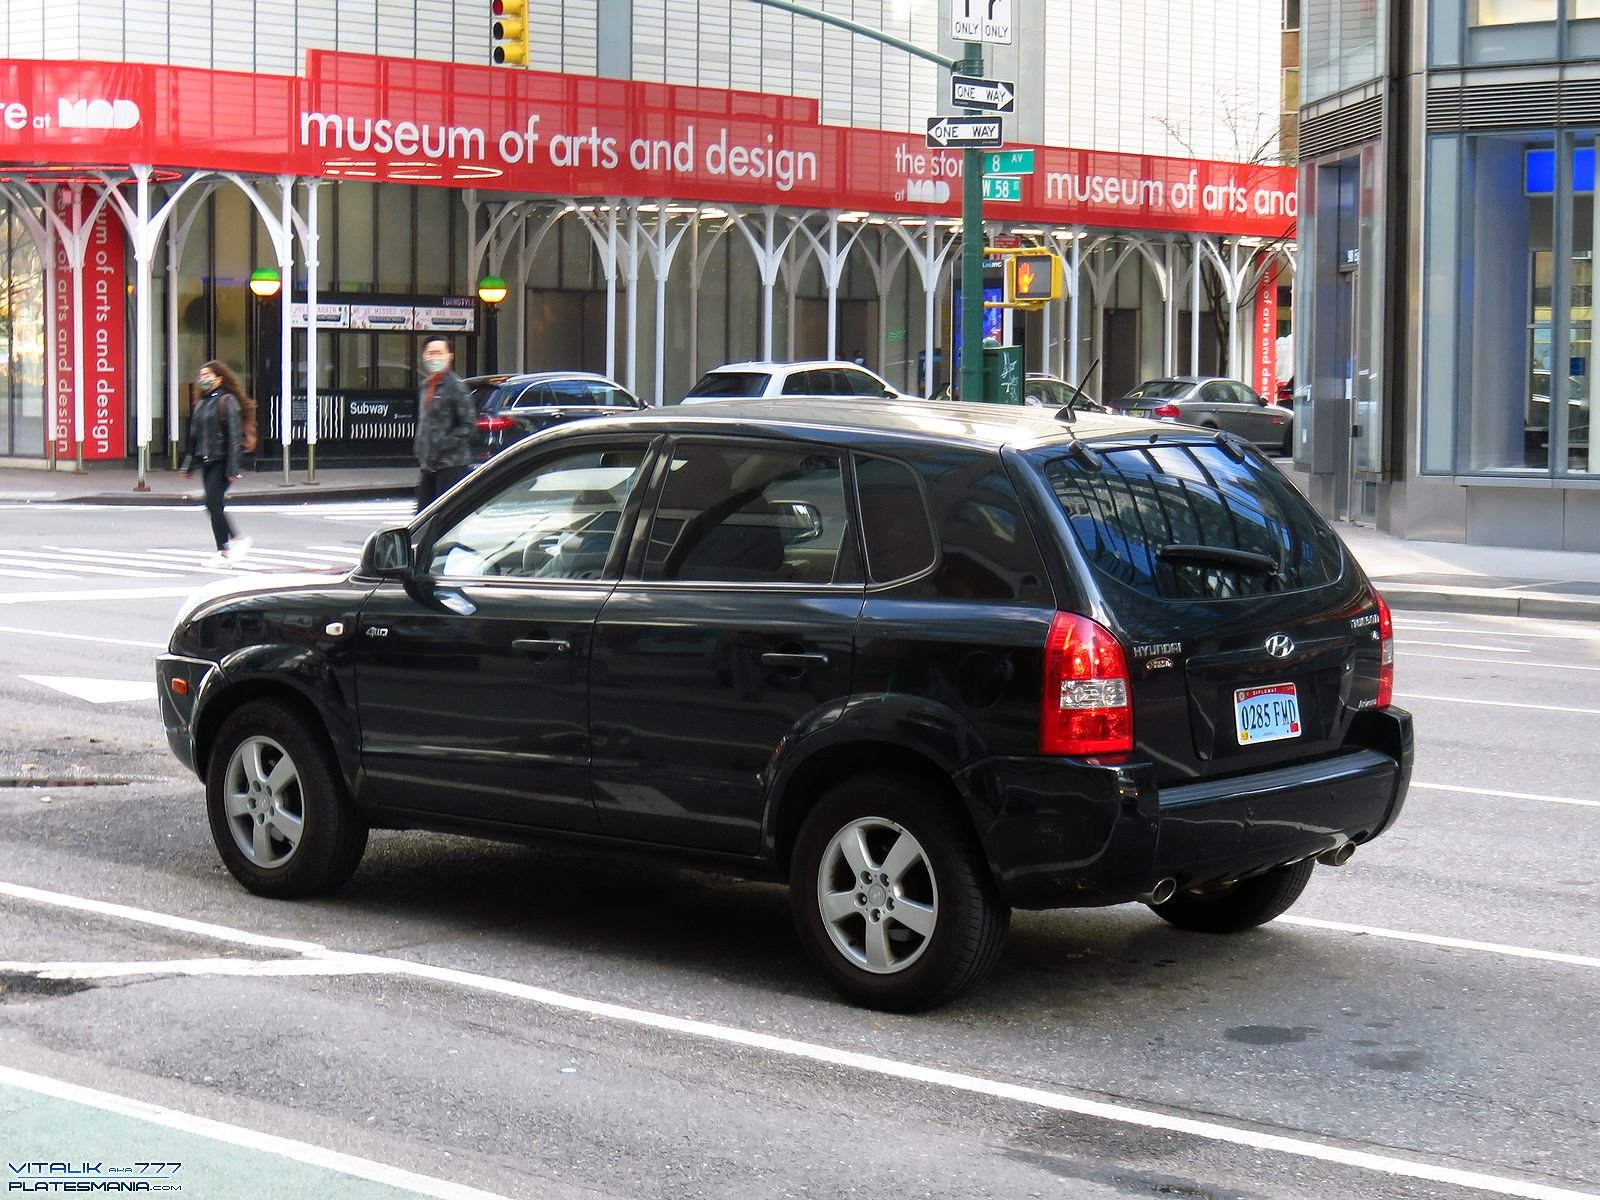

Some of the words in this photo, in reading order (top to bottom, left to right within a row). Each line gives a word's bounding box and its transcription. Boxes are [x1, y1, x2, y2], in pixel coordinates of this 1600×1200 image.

[955, 21, 979, 35] ONLY
[985, 25, 1008, 38] ONLY
[957, 86, 975, 99] ONE
[986, 89, 1006, 101] WAY
[33, 113, 50, 128] at
[935, 126, 959, 138] ONE
[972, 126, 996, 138] WAY
[301, 112, 485, 161] museum
[500, 115, 540, 164] of
[549, 126, 619, 169] arts
[630, 125, 694, 172] and
[706, 128, 816, 191] design
[895, 143, 925, 175] the
[992, 155, 1000, 172] 8
[1011, 154, 1023, 163] AV
[982, 180, 991, 197] W
[995, 180, 1009, 198] 58
[1047, 172, 1163, 206] museum
[1171, 169, 1197, 208] of
[1202, 178, 1247, 213] arts
[1254, 178, 1297, 217] and
[96, 251, 114, 274] of
[58, 280, 70, 320] arts
[96, 280, 111, 322] arts
[1263, 308, 1271, 334] arts
[58, 329, 72, 372] and
[96, 329, 115, 372] and
[1262, 338, 1271, 365] and
[57, 379, 72, 453] design
[92, 379, 115, 453] design
[350, 401, 389, 417] Subway
[1133, 642, 1181, 657] HYUNDAI
[1252, 687, 1277, 696] DIPLOMAT
[1241, 703, 1271, 731] 0285
[1273, 699, 1296, 726] FMD
